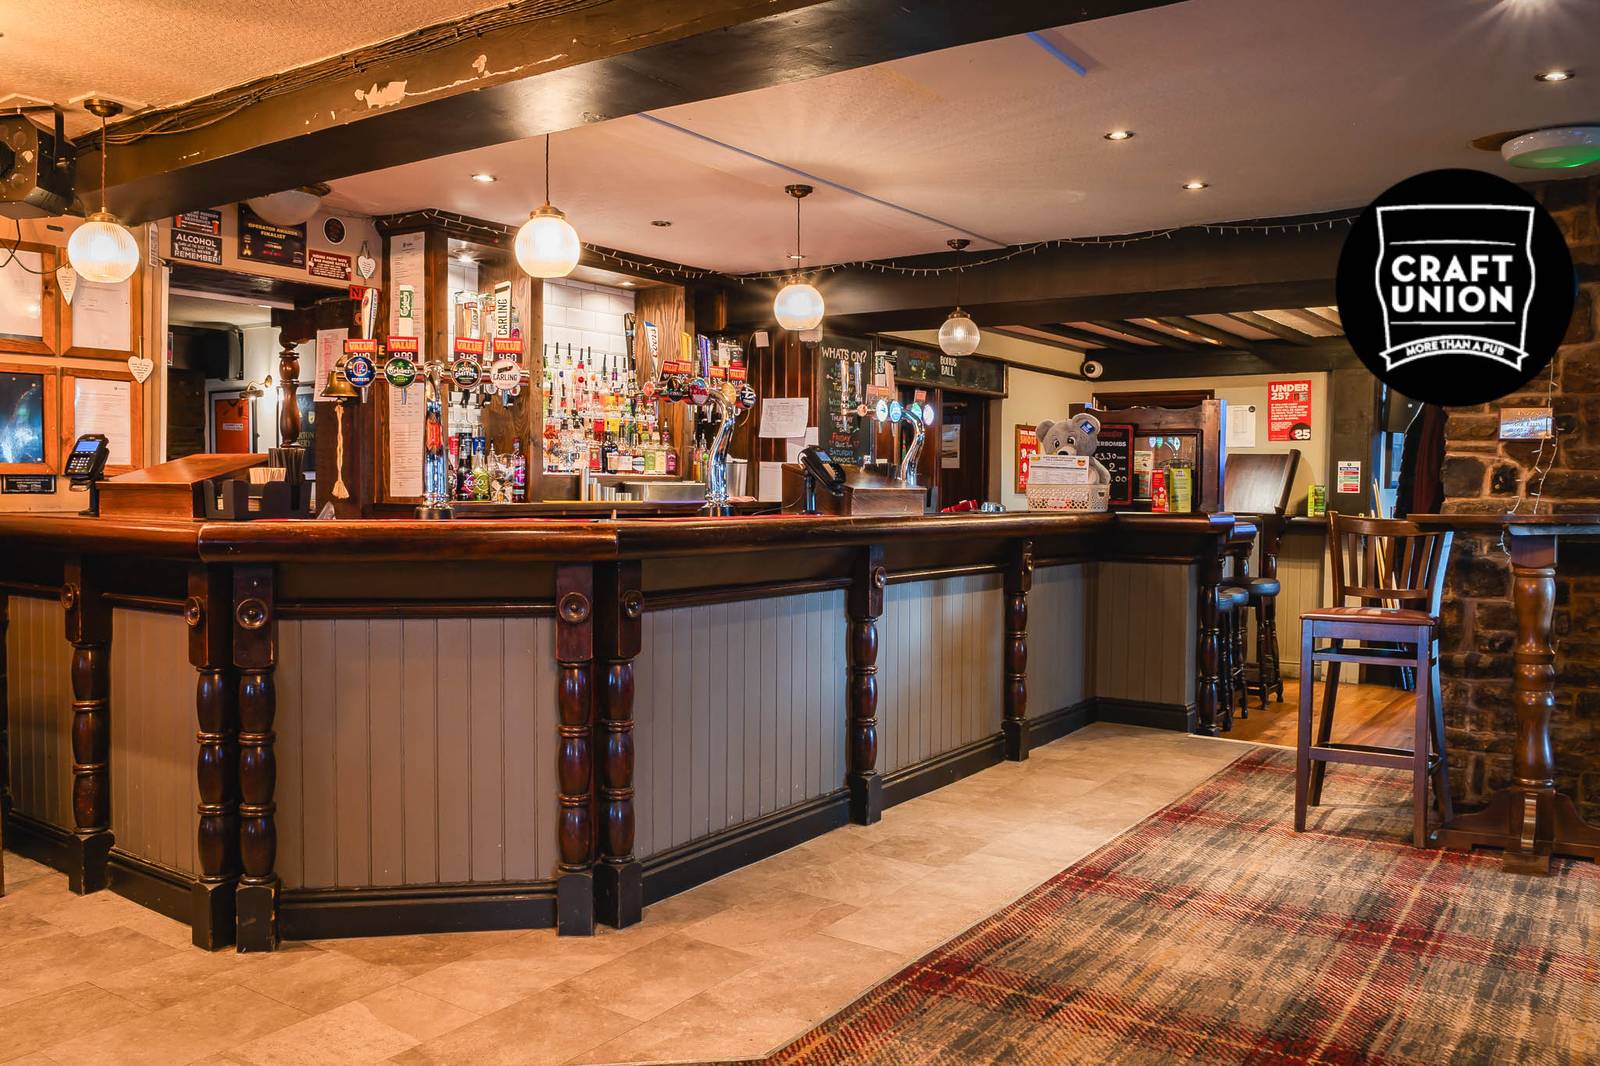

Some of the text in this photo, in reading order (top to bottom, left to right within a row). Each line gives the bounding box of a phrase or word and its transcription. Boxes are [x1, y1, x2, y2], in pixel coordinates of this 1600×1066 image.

[176, 233, 217, 248] ALCOHOL
[260, 230, 286, 240] FINALIST
[174, 250, 221, 263] REMEMBER!
[497, 298, 508, 336] CARLING
[349, 342, 374, 351] VALUE
[390, 340, 417, 350] VALUE
[457, 341, 483, 352] VALUE
[495, 342, 521, 351] VALUE
[821, 347, 867, 362] WHATS ON?
[940, 355, 957, 367] BONUS
[941, 365, 955, 377] BALL
[493, 373, 518, 381] CARLING
[1271, 383, 1309, 392] UNDER
[1271, 392, 1290, 400] 25?
[1294, 429, 1311, 440] 25
